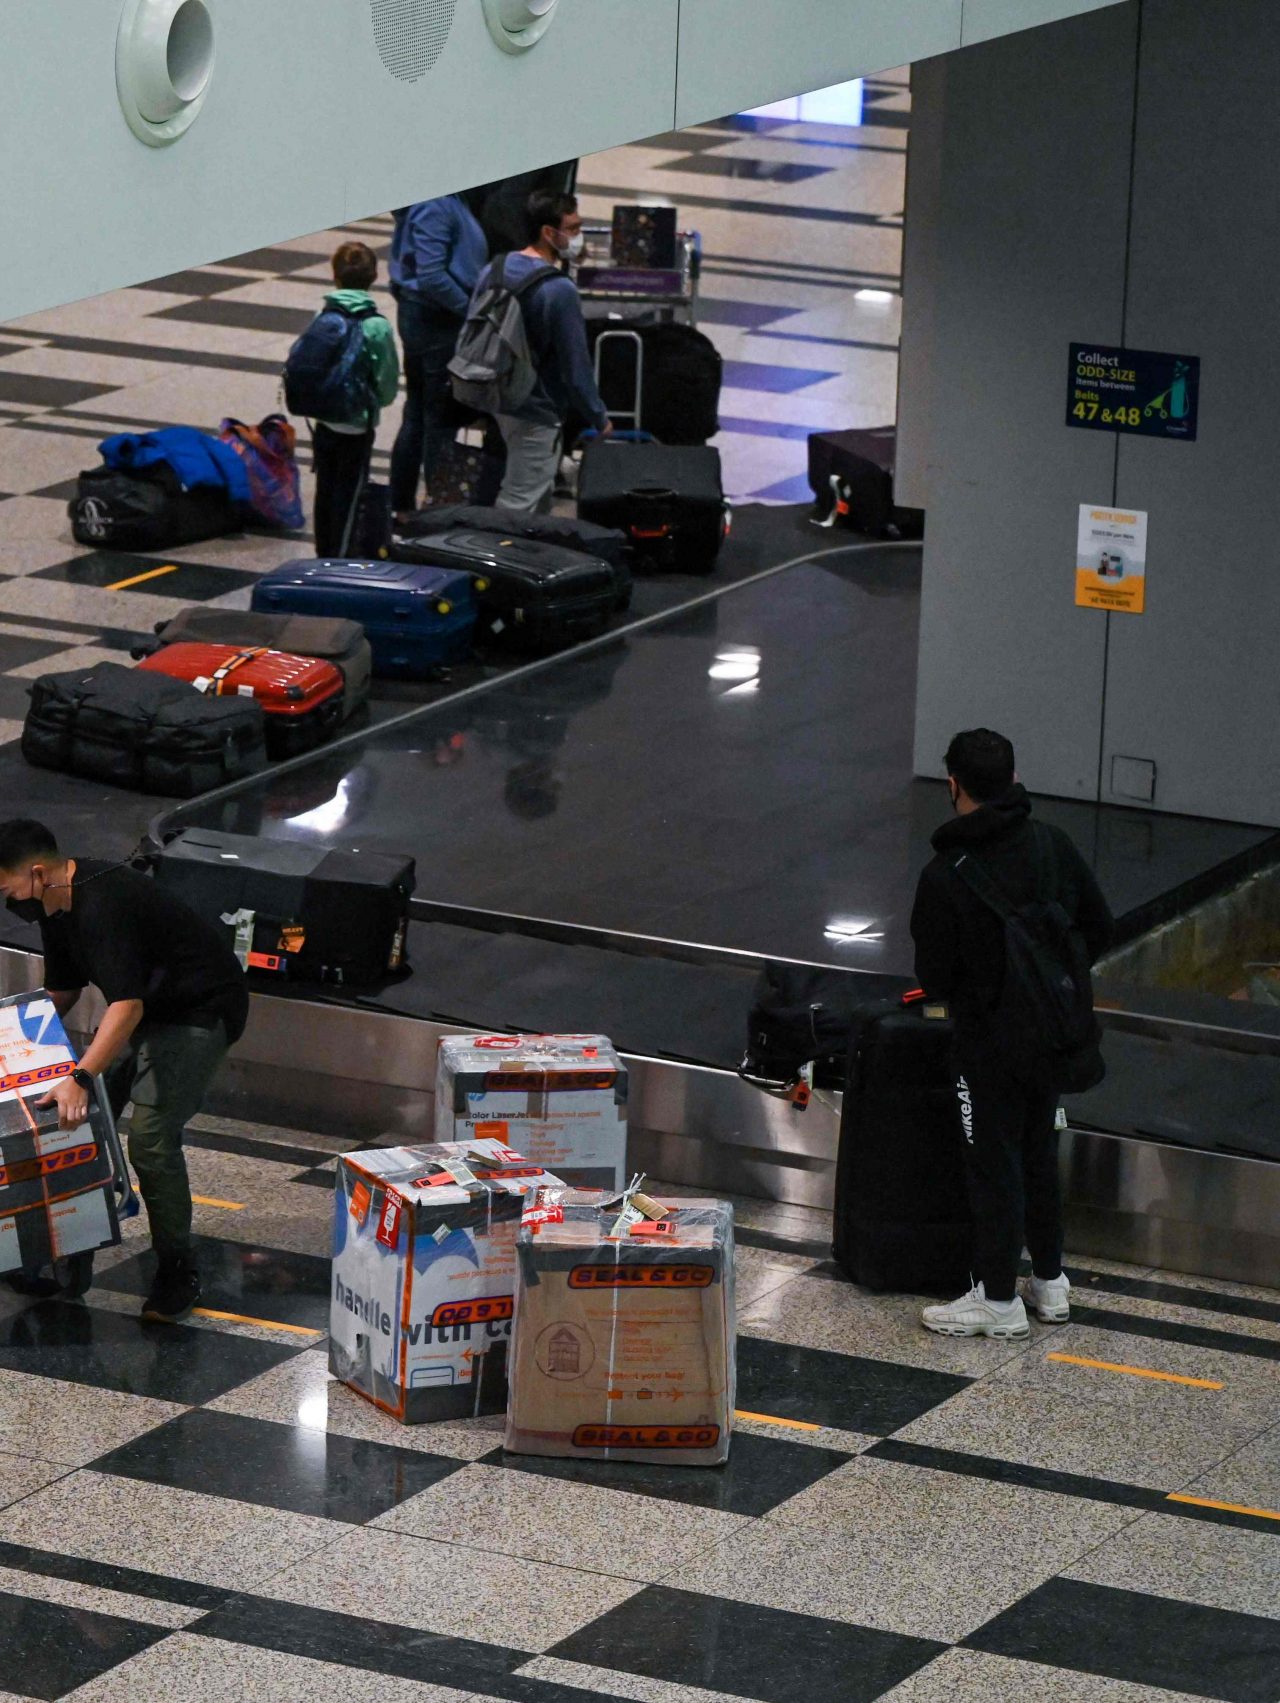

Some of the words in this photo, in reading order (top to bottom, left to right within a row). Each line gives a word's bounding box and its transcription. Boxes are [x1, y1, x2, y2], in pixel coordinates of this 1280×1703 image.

[1077, 351, 1119, 367] Collect
[1076, 364, 1136, 382] ODD-SIZE
[1100, 378, 1136, 391] between
[1074, 388, 1100, 401] Belts
[1072, 401, 1099, 421] 47
[1100, 407, 1113, 423] &
[1114, 405, 1141, 426] 48
[16, 1074, 32, 1085] &
[37, 1064, 71, 1080] GO
[575, 1268, 644, 1283] SEAL
[649, 1268, 669, 1282] &
[671, 1268, 709, 1282] GO
[335, 1272, 392, 1337] handle
[580, 1429, 647, 1443] SEAL
[652, 1429, 671, 1442] &
[676, 1429, 713, 1442] GO
